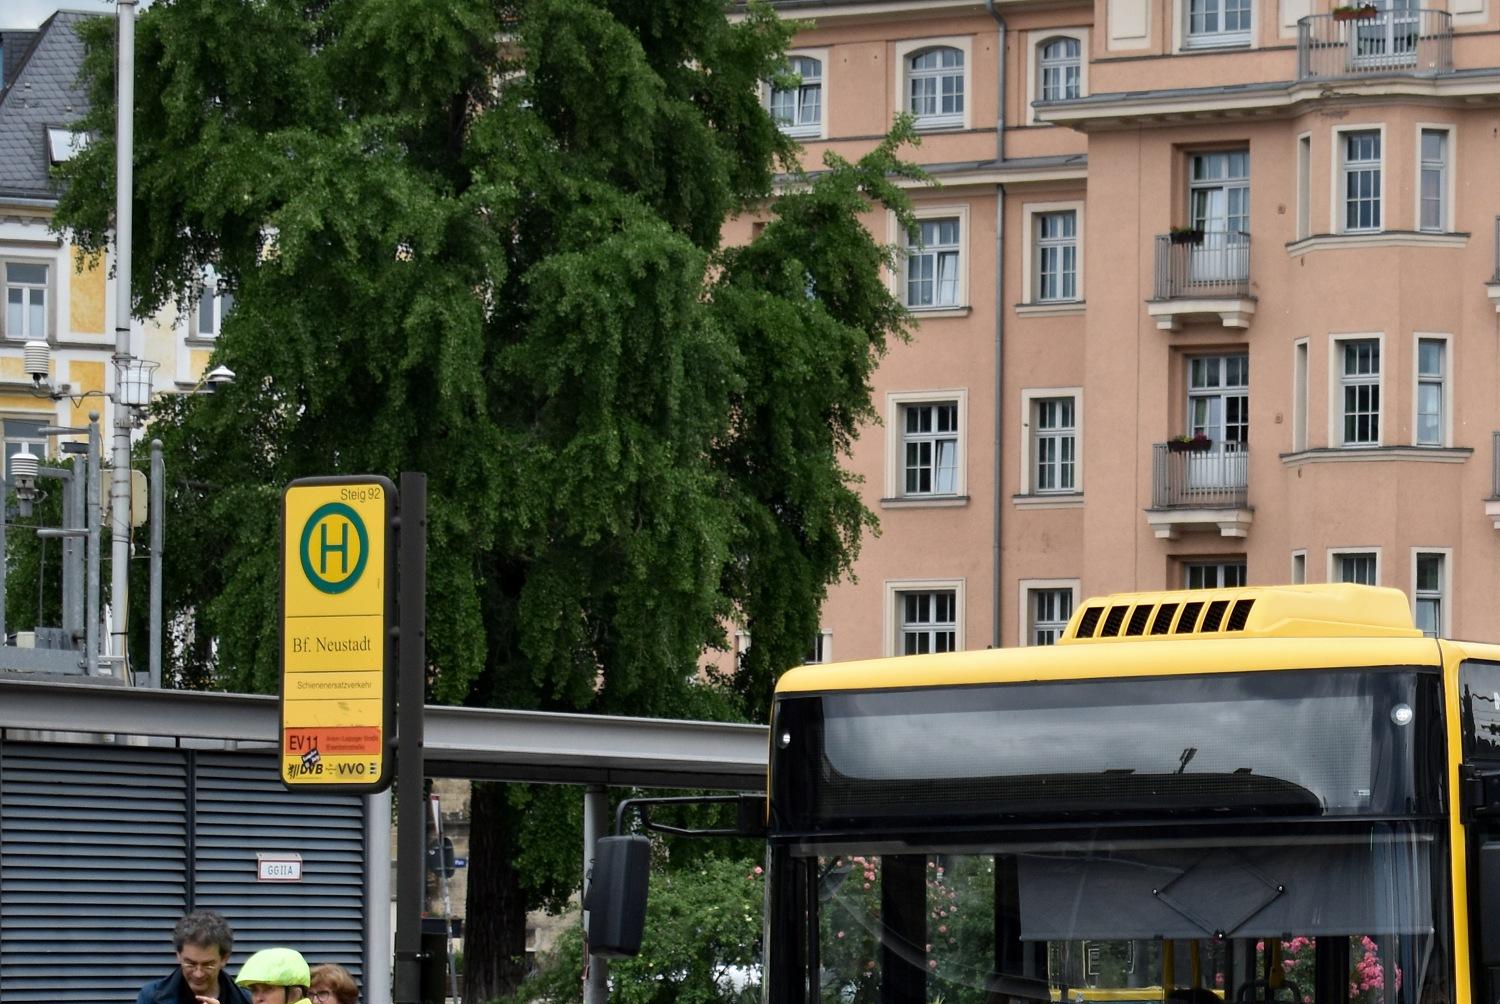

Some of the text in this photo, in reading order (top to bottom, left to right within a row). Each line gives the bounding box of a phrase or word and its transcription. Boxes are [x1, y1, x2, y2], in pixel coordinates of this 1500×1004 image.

[340, 487, 381, 503] Steig 92
[320, 523, 349, 574] H
[293, 635, 371, 653] Bf. Neustadt
[338, 763, 365, 775] VVO
